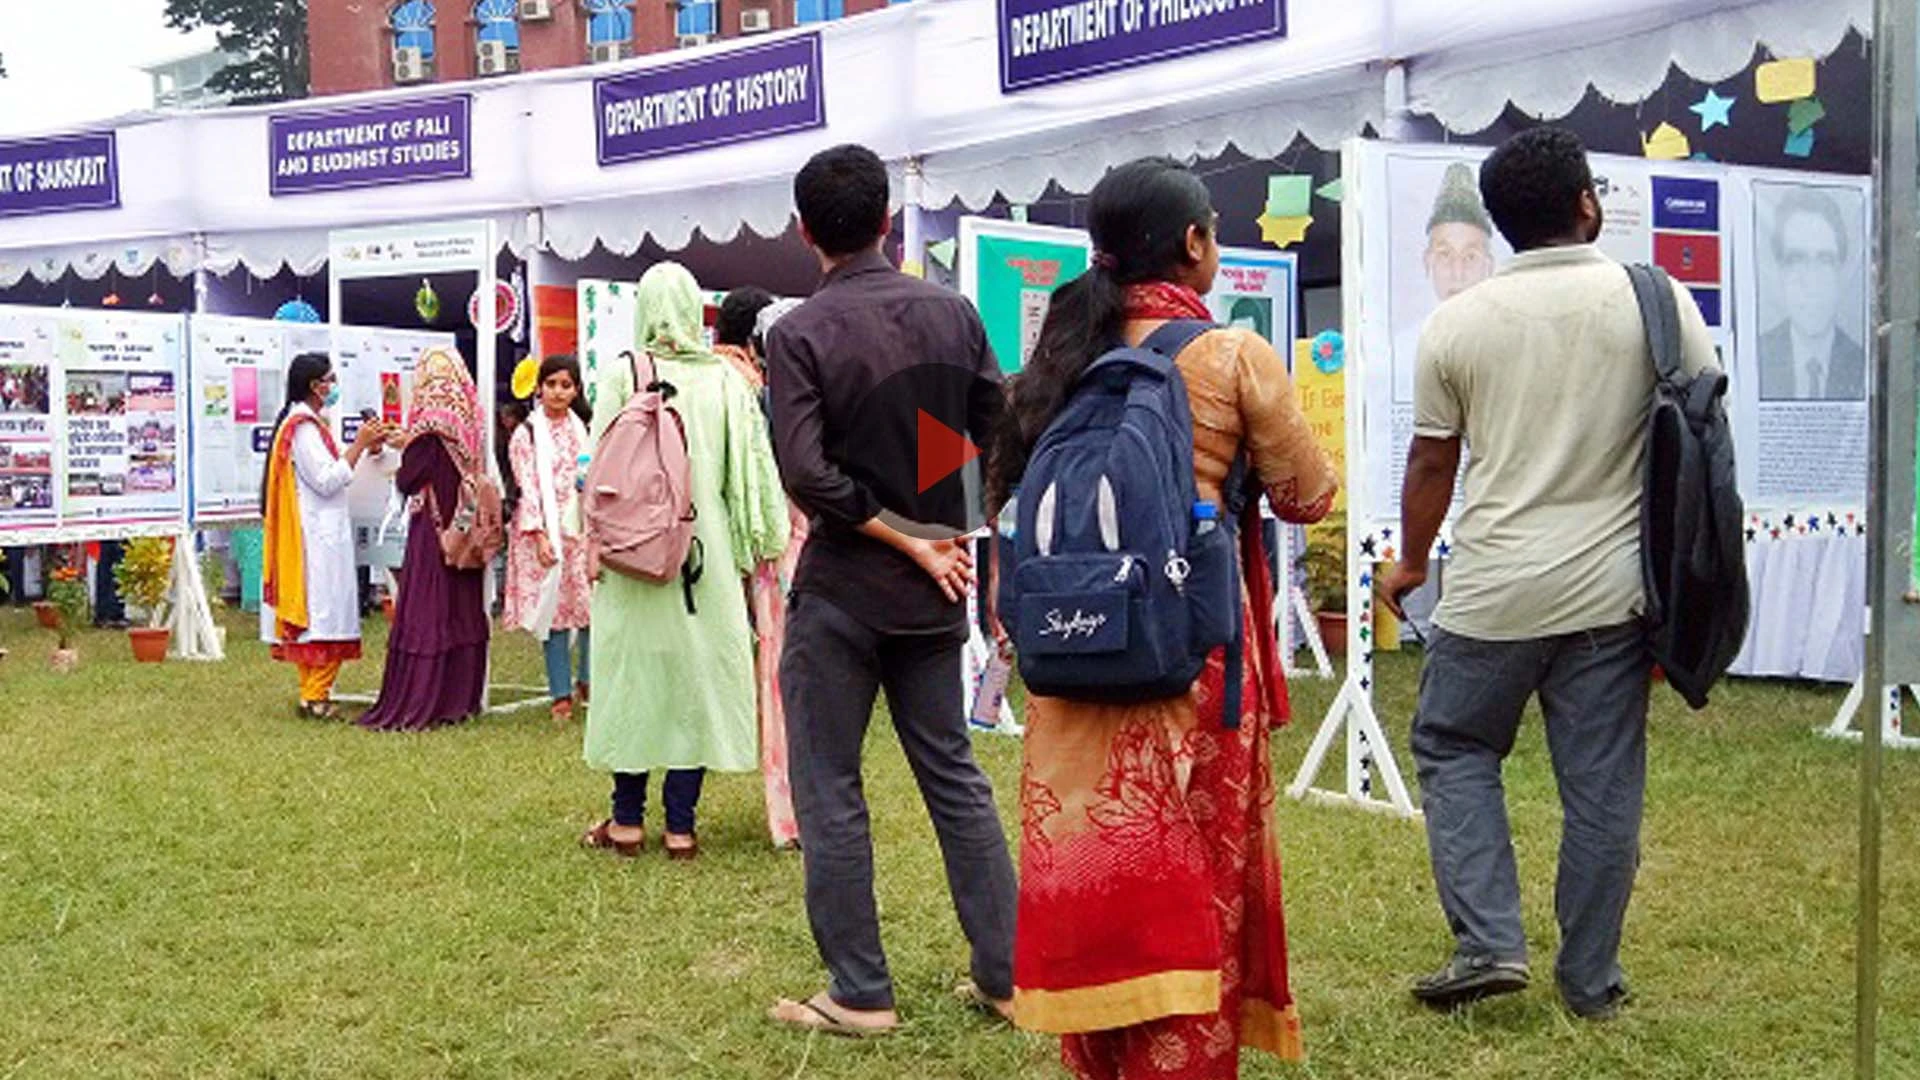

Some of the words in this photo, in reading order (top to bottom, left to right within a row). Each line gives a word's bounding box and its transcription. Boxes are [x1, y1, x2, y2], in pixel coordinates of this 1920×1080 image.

[1011, 0, 1117, 57] DEPARTMENT
[1121, 0, 1144, 33] OF
[605, 86, 707, 136] DEPARTMENT
[711, 80, 732, 117] OF
[736, 64, 808, 113] HISTORY
[287, 124, 387, 151] DEPARTMENT
[391, 121, 411, 138] OF
[416, 115, 449, 137] PALI
[14, 162, 33, 191] OF
[36, 155, 106, 190] SANSKRIT
[278, 157, 308, 176] AND
[312, 148, 388, 173] BUDDHIST
[392, 141, 460, 164] STUDIES
